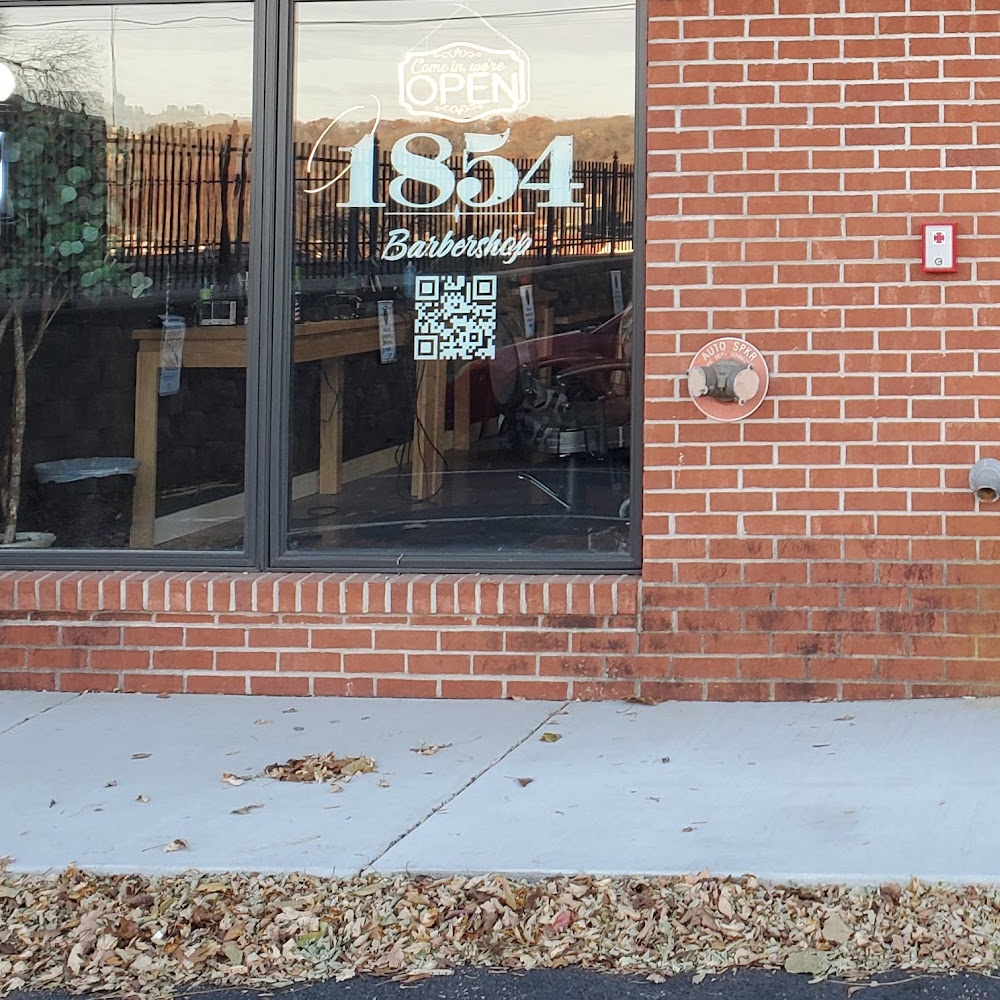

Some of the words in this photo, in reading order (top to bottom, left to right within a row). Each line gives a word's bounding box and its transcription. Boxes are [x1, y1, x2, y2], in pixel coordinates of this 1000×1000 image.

[410, 58, 449, 74] Come
[469, 58, 505, 72] we're
[406, 72, 519, 106] OPEN
[335, 127, 585, 208] 1854
[381, 228, 532, 265] Barbershop
[701, 341, 726, 361] AUTO
[733, 341, 757, 361] SPKR
